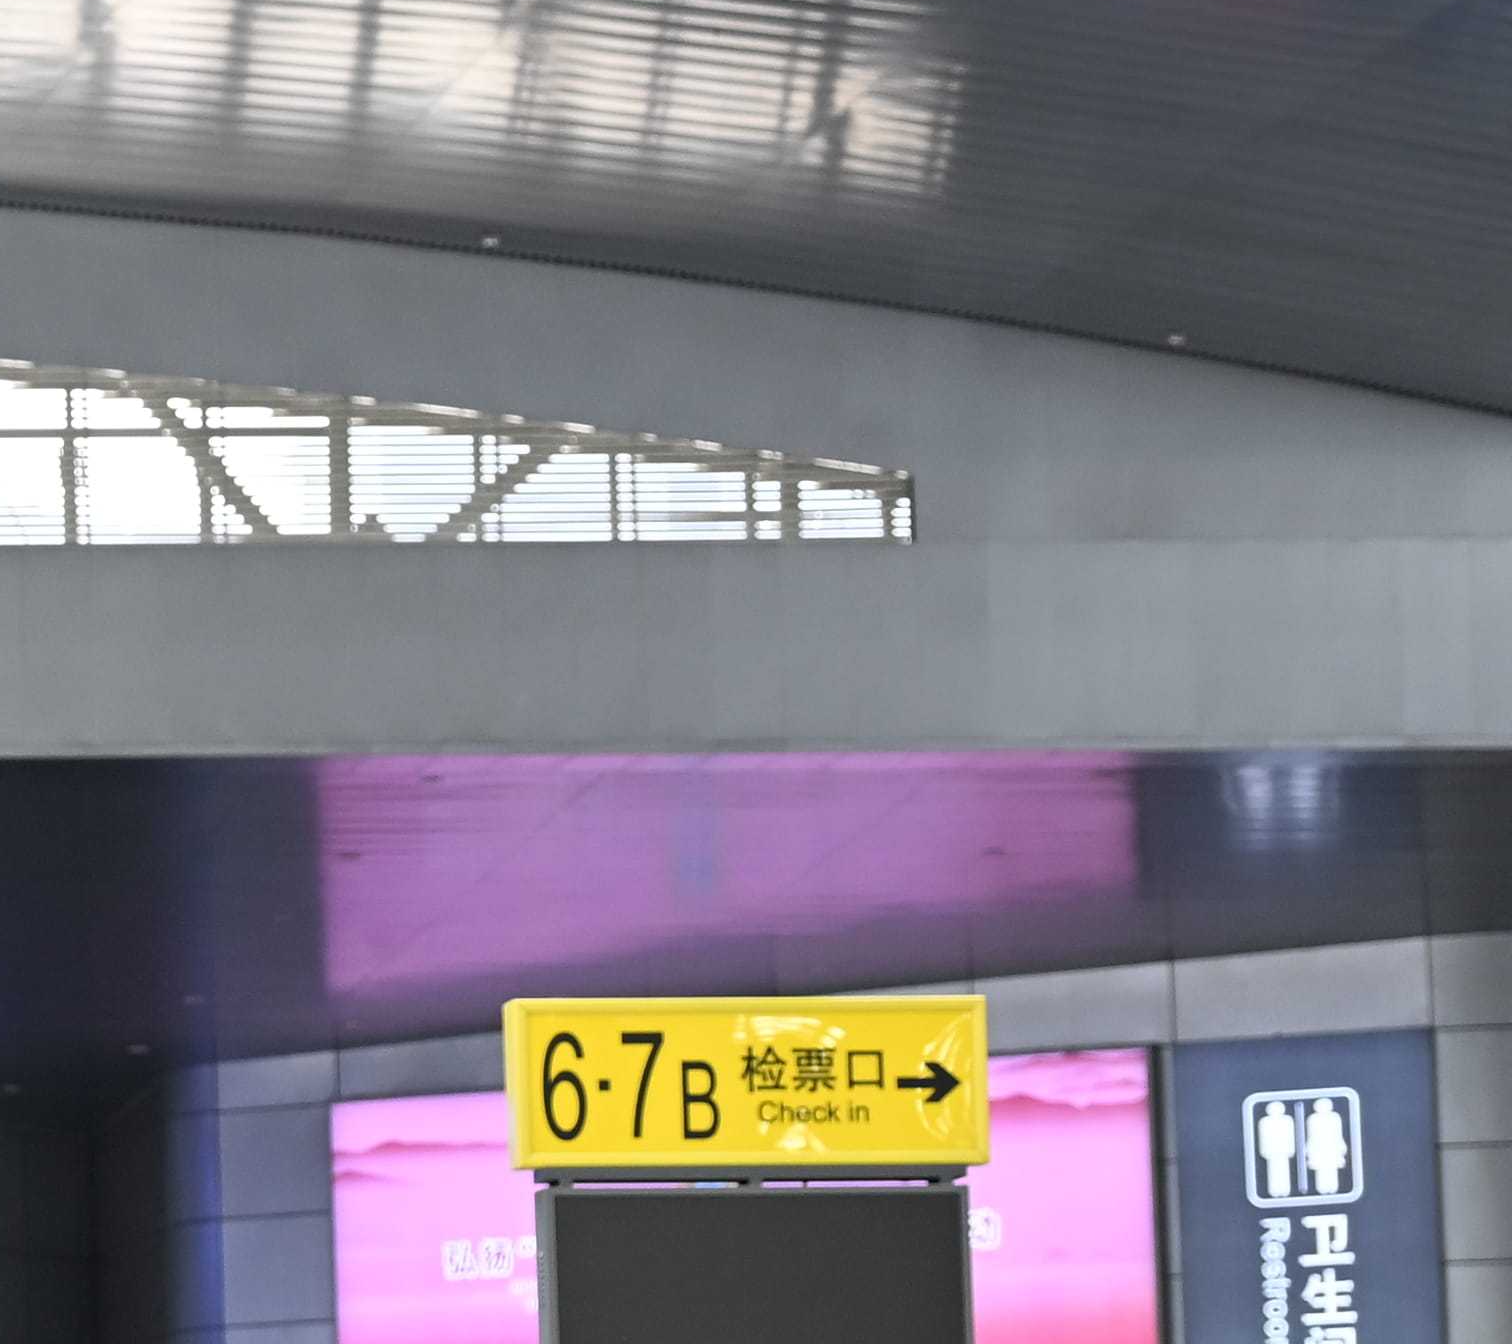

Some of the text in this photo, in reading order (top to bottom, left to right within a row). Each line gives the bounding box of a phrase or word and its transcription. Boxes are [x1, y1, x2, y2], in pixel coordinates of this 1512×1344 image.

[740, 1047, 887, 1094] 检票口
[757, 1100, 870, 1125] Check in
